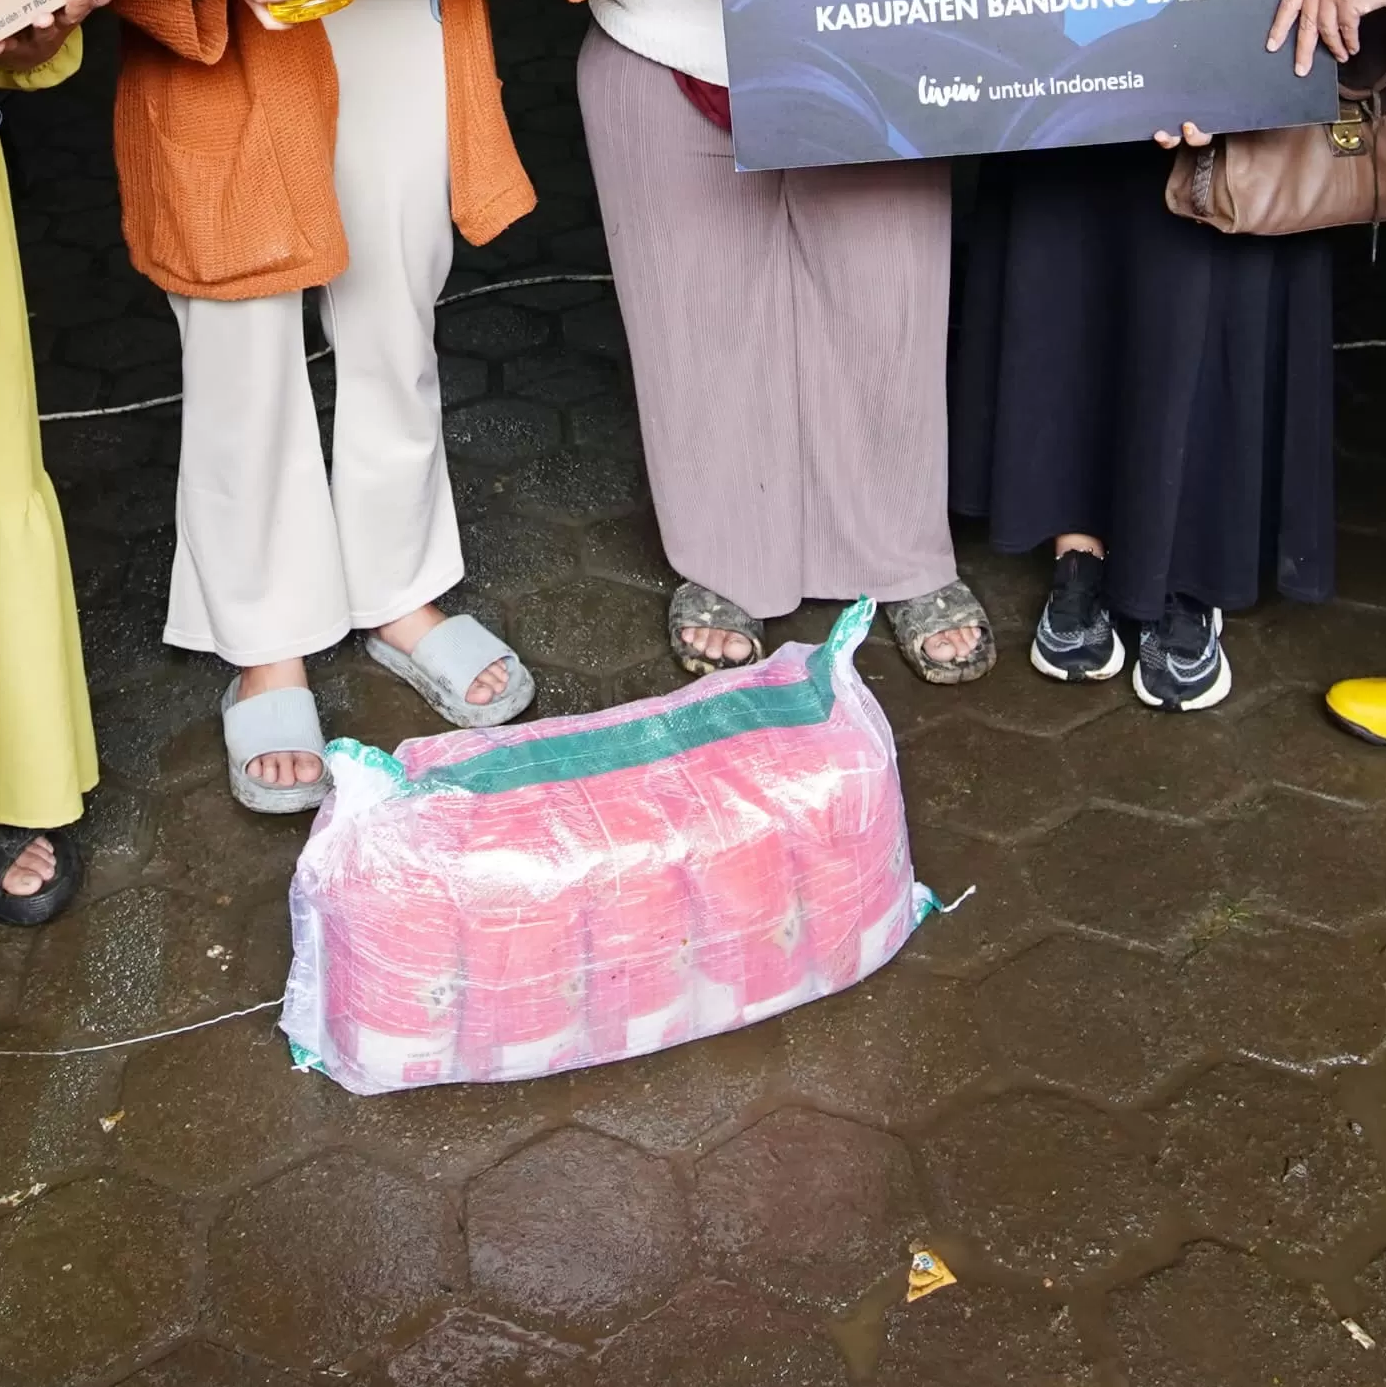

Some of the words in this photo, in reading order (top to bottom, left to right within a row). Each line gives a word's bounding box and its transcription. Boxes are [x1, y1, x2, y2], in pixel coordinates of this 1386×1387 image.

[21, 4, 34, 15] PT
[988, 77, 1047, 99] untuk
[1049, 69, 1145, 96] Indonesia
